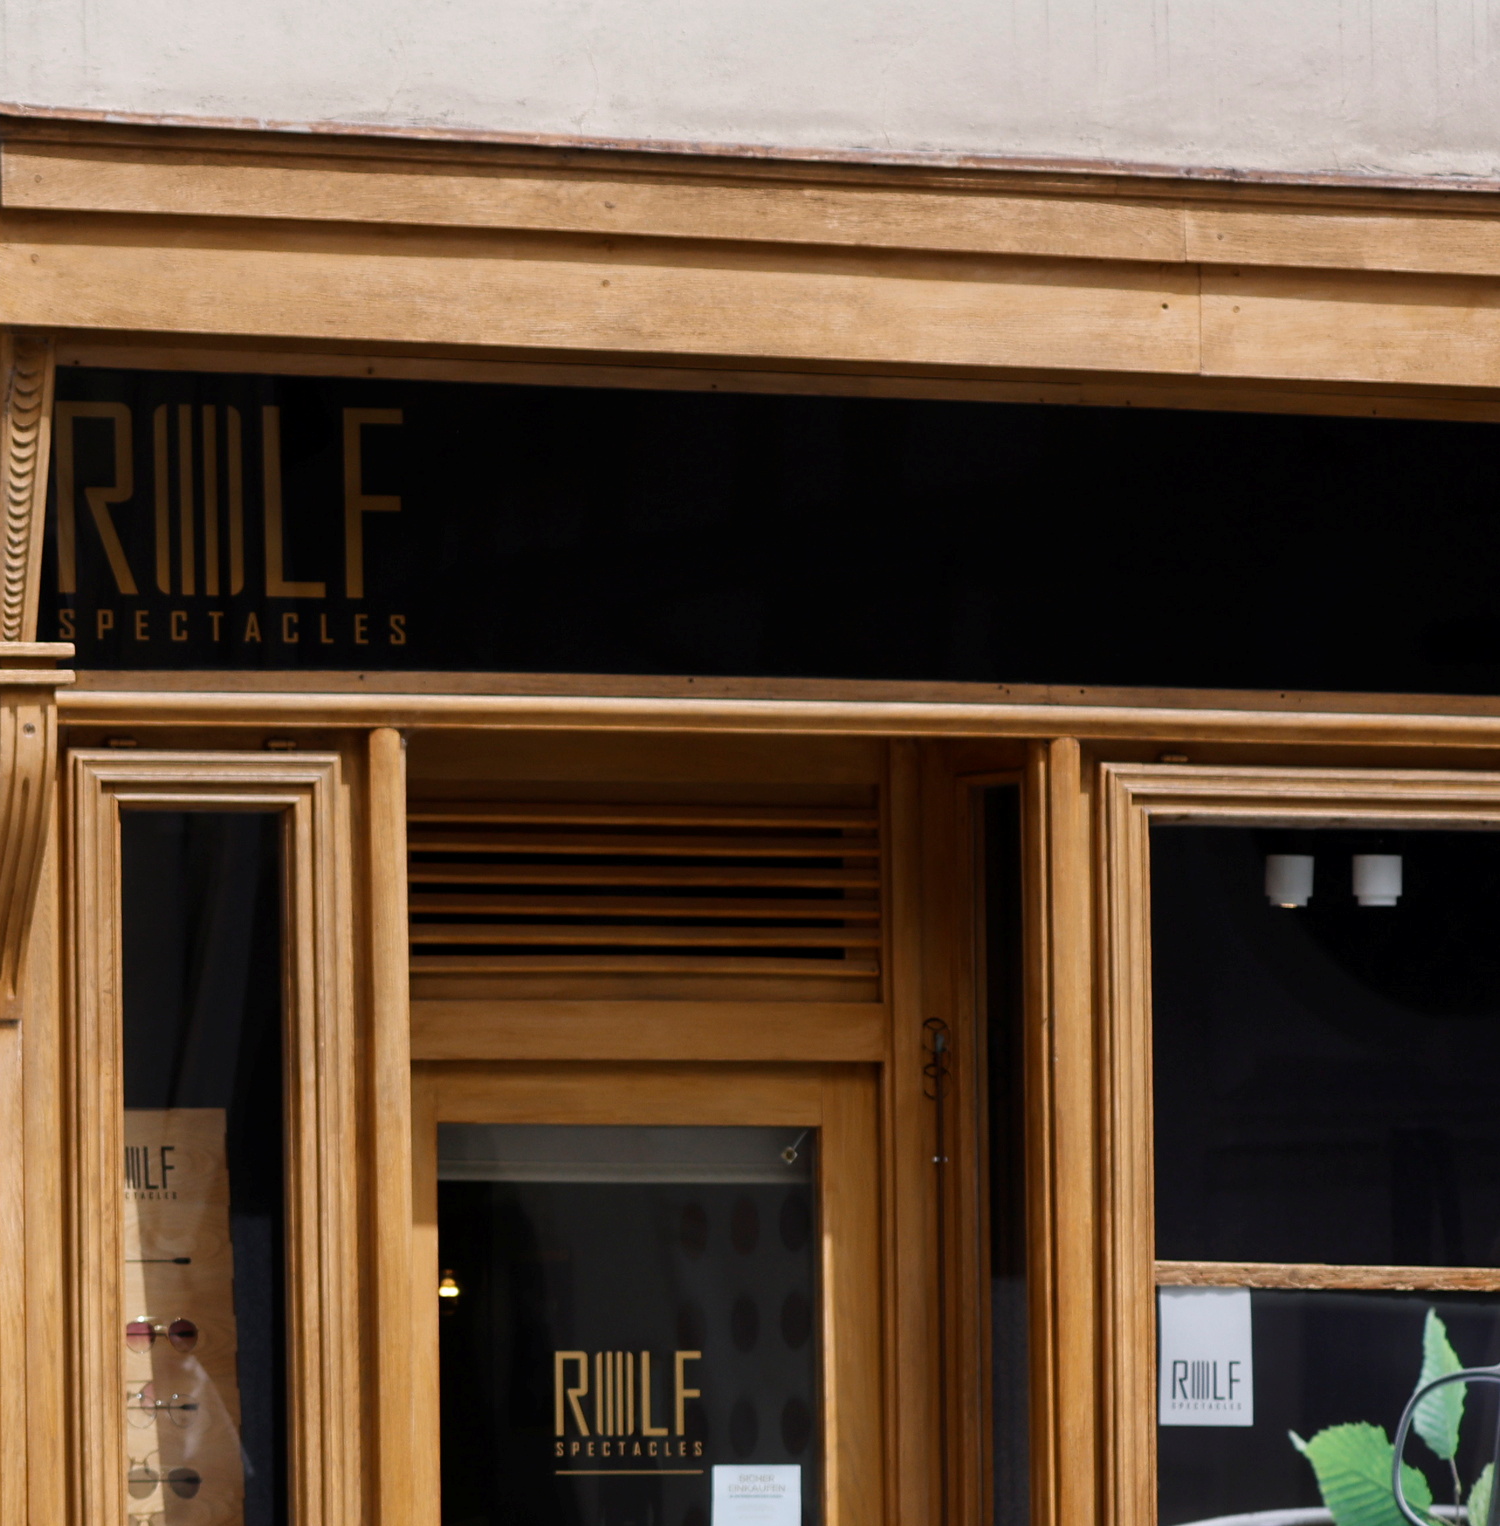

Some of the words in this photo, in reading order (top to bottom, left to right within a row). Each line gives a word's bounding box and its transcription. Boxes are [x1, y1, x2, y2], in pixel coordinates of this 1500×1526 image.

[58, 608, 407, 645] SPECTACLES
[1171, 1402, 1242, 1411] SPECTACLES
[555, 1441, 703, 1457] SPECTACLES
